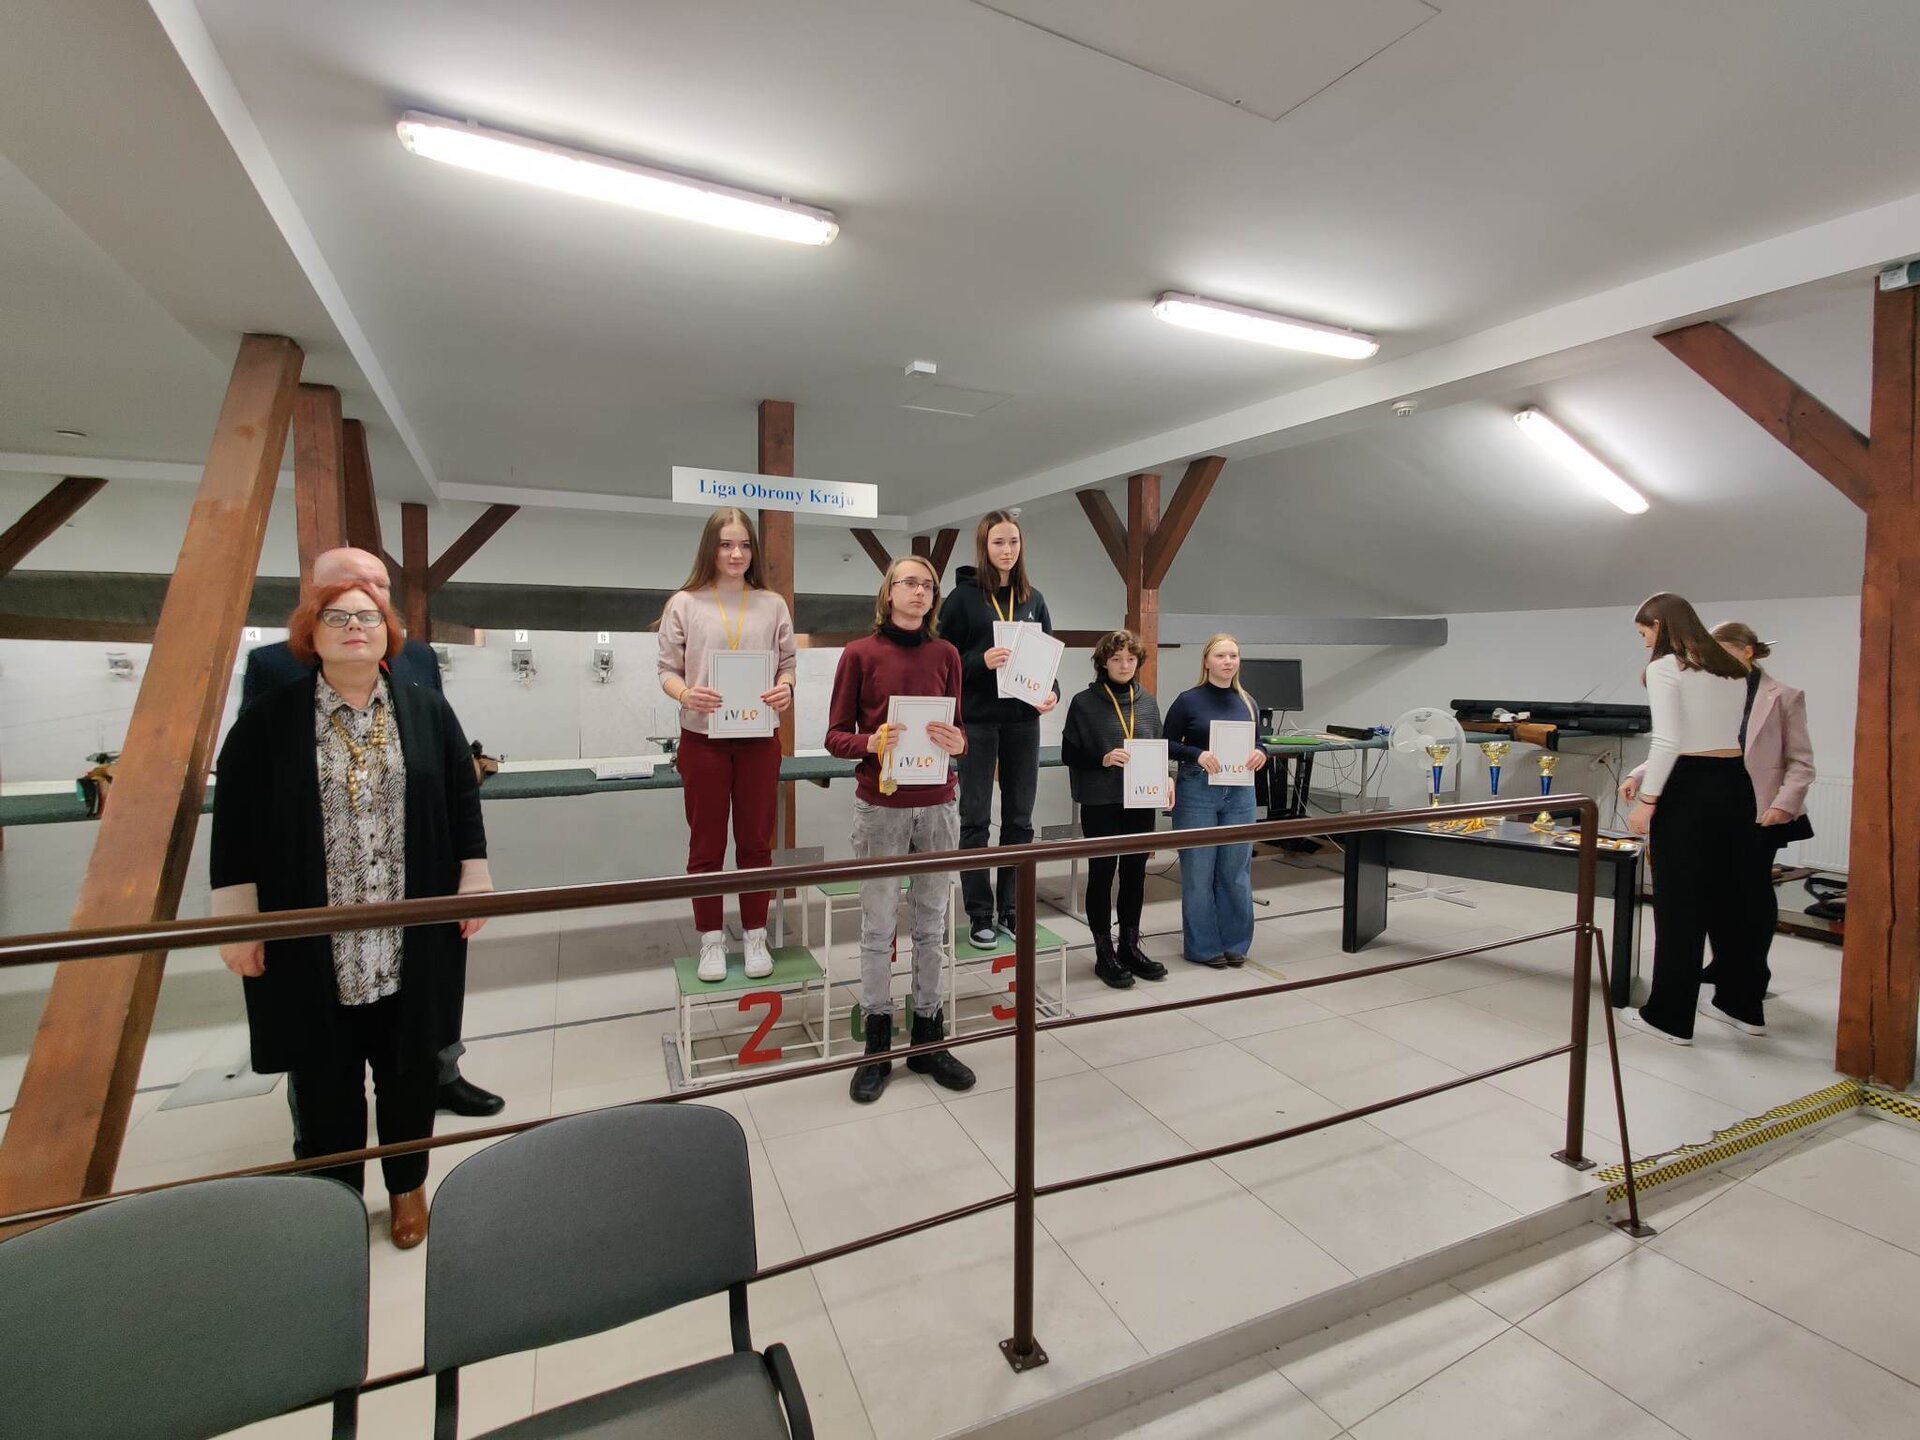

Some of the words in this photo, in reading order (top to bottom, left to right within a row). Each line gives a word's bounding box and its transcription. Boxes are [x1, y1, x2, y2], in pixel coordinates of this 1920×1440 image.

[698, 479, 737, 499] Liga
[742, 483, 804, 505] Obrony
[809, 488, 854, 508] Kraju
[738, 991, 783, 1065] 2
